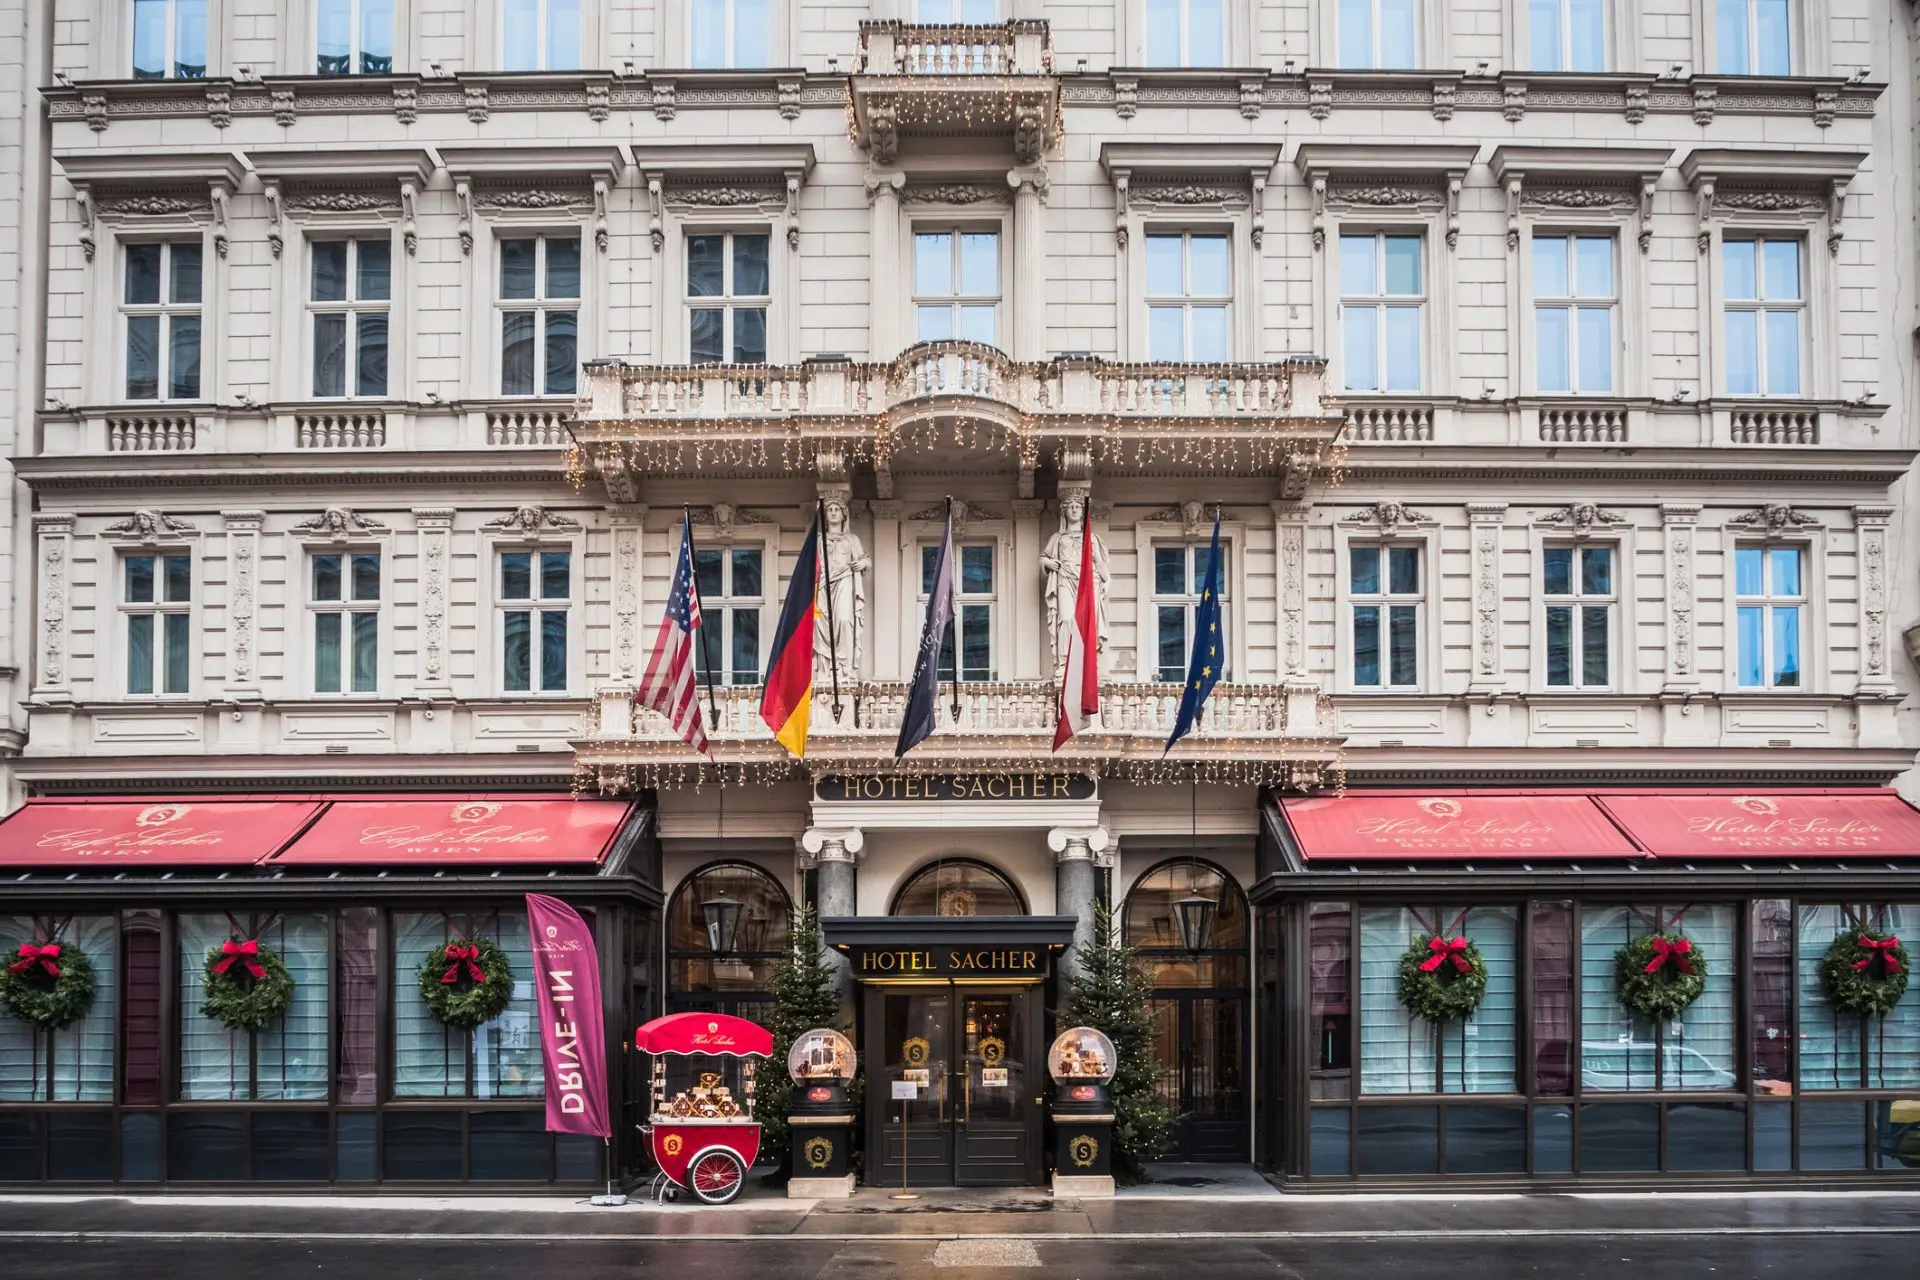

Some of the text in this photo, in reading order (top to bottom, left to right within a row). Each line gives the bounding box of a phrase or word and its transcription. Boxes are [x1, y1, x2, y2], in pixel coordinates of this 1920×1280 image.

[844, 777, 1071, 798] HOTEL SACHER
[465, 808, 482, 818] S
[1356, 817, 1458, 834] Hotel
[1687, 816, 1884, 833] Hotel Sacher
[863, 951, 1037, 970] HOTEL SACHER
